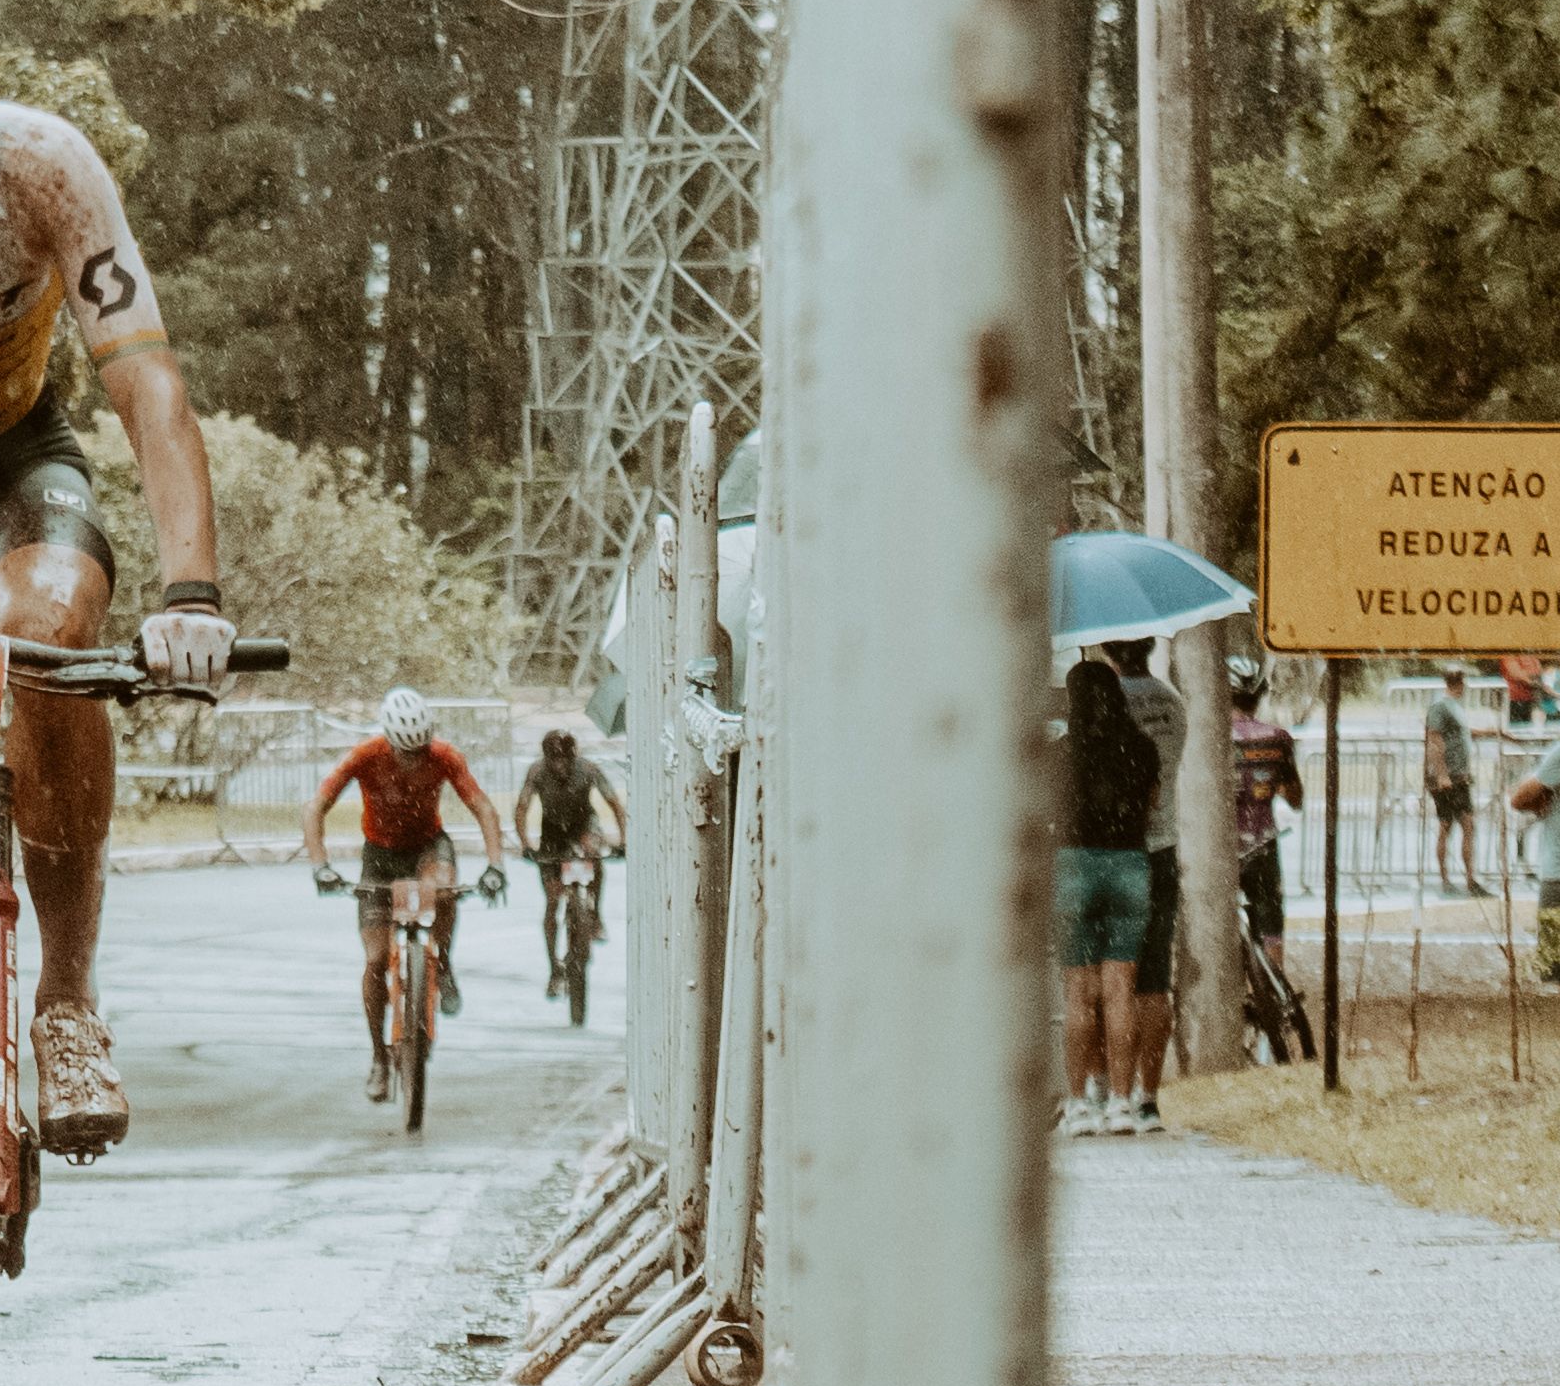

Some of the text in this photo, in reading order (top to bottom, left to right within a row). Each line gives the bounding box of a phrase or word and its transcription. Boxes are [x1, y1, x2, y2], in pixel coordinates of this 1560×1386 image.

[1388, 467, 1547, 505] ATENÇÃO
[1379, 530, 1553, 557] REDUZA A
